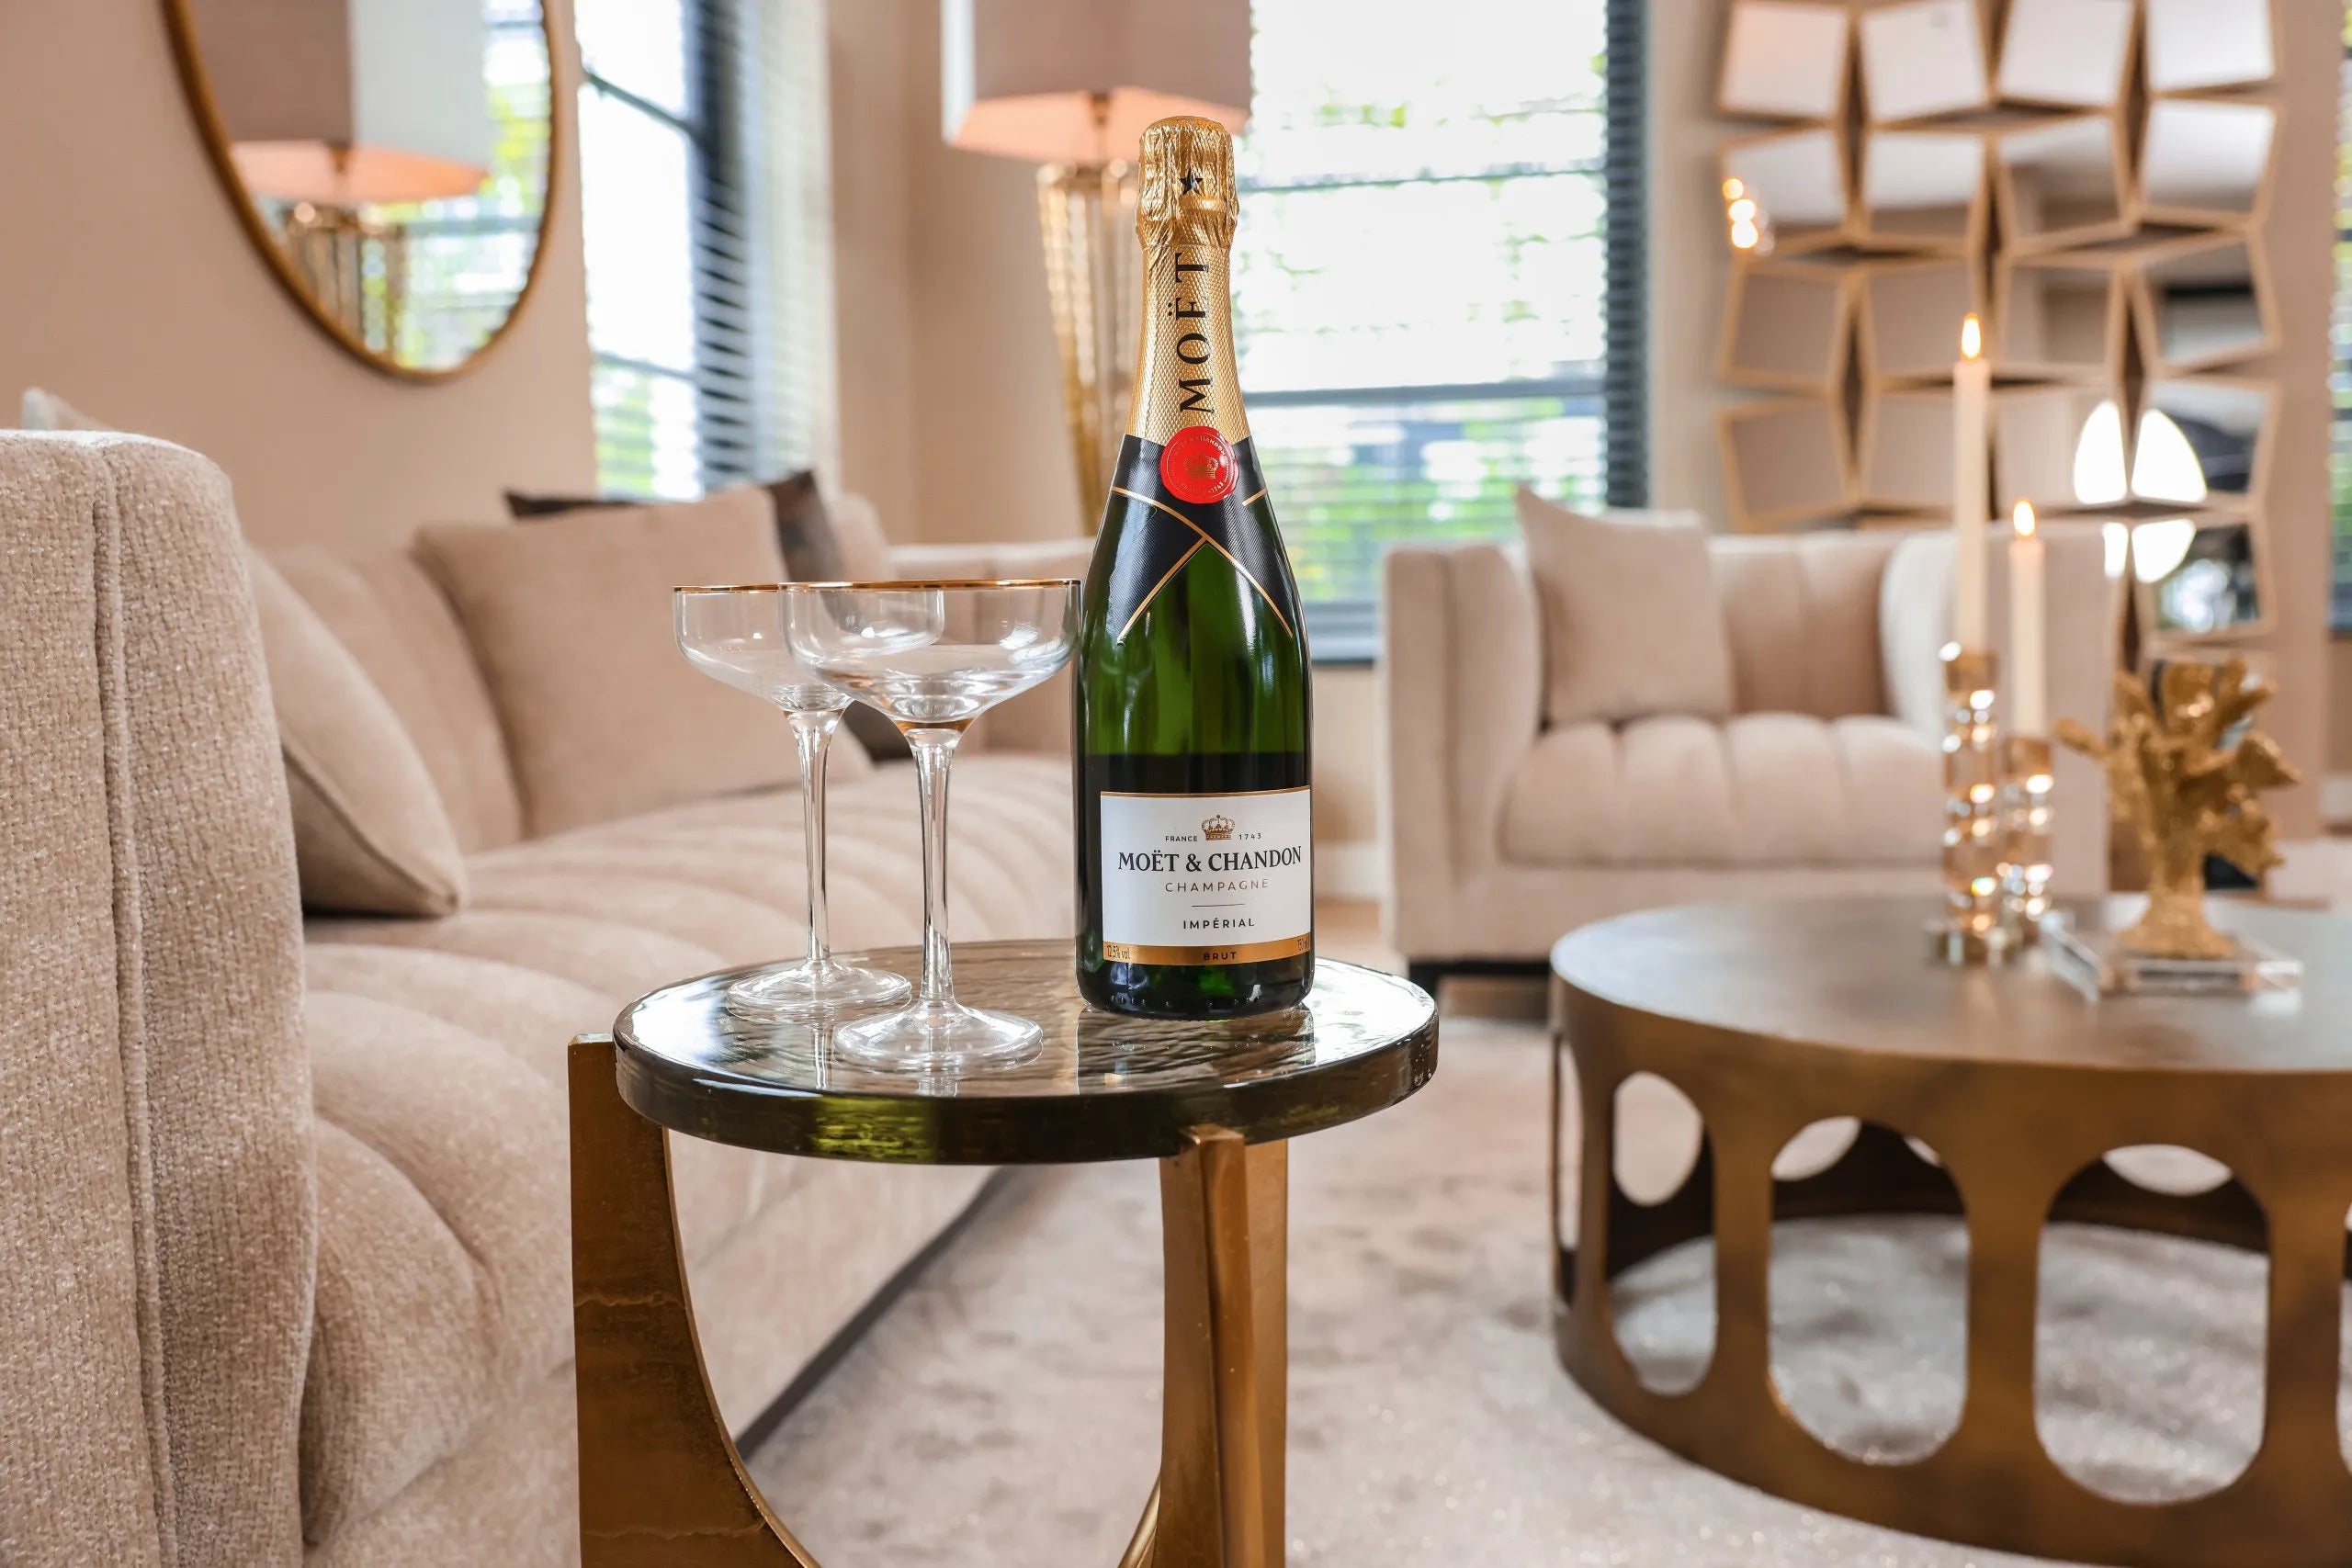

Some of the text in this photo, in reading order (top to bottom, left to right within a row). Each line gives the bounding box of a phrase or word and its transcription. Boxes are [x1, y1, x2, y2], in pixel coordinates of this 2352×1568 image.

[1238, 832, 1261, 840] 1743
[1118, 846, 1302, 872] MOËT & CHANDON
[1165, 878, 1268, 892] CHAMPAGNE
[1183, 918, 1255, 930] IMPÉRIAL
[1204, 952, 1237, 961] BRUT
